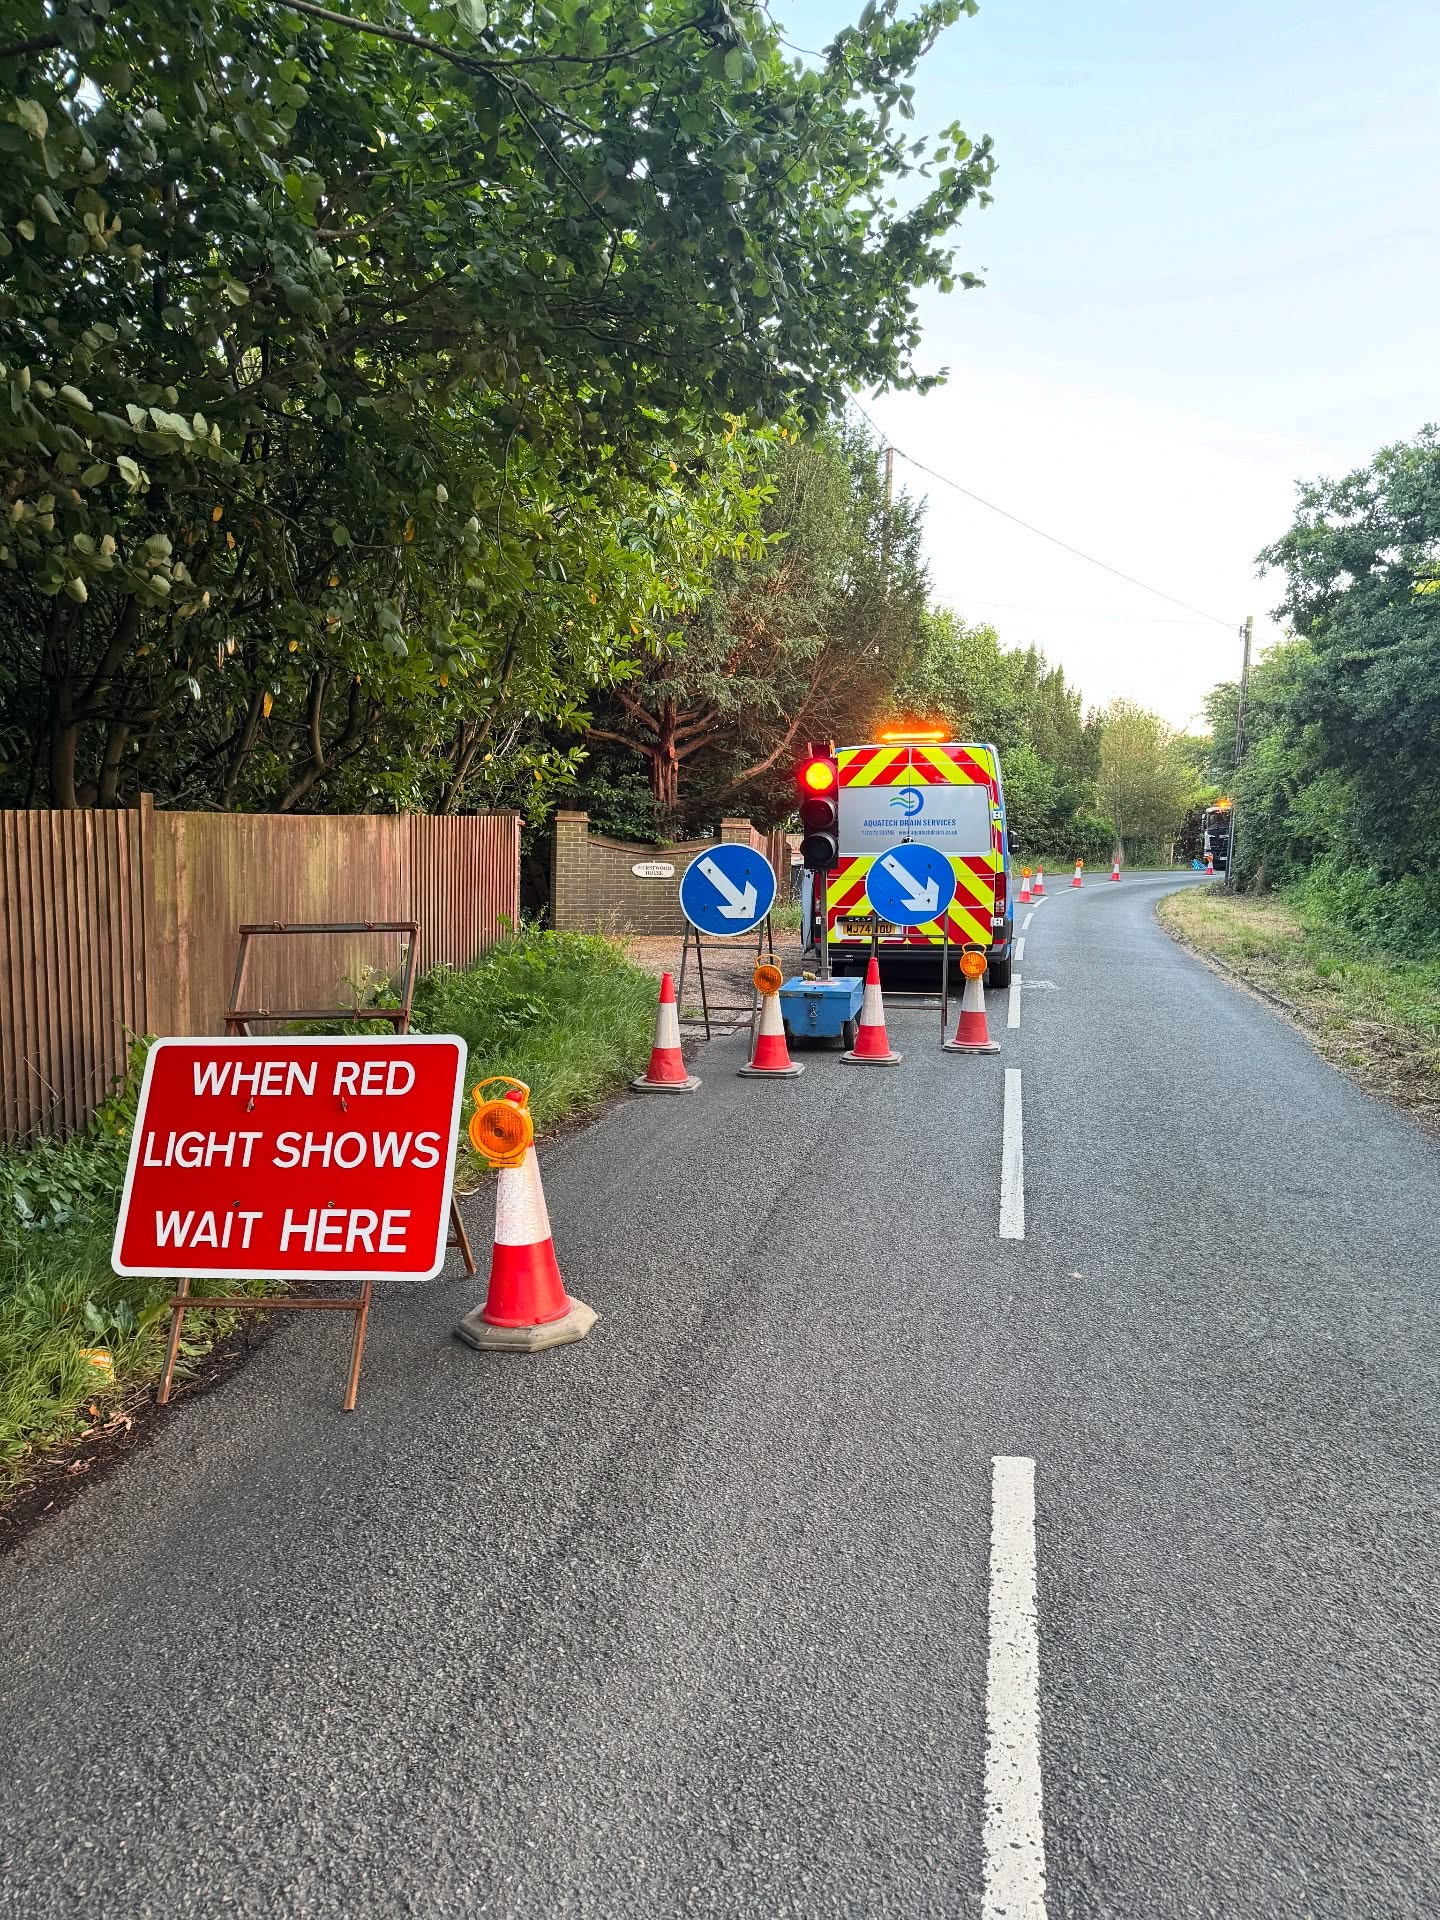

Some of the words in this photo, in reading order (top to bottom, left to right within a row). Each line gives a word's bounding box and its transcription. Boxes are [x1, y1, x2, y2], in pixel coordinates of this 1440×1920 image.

[864, 819, 898, 828] AQUATECH
[899, 819, 921, 827] DRAIN
[922, 818, 956, 826] SERVICES
[847, 925, 871, 934] MJ74
[193, 1061, 318, 1096] WHEN
[333, 1061, 416, 1096] RED
[143, 1131, 263, 1168] LIGHT
[272, 1131, 441, 1169] SHOWS
[155, 1210, 263, 1249] WAIT
[280, 1208, 411, 1253] HERE
